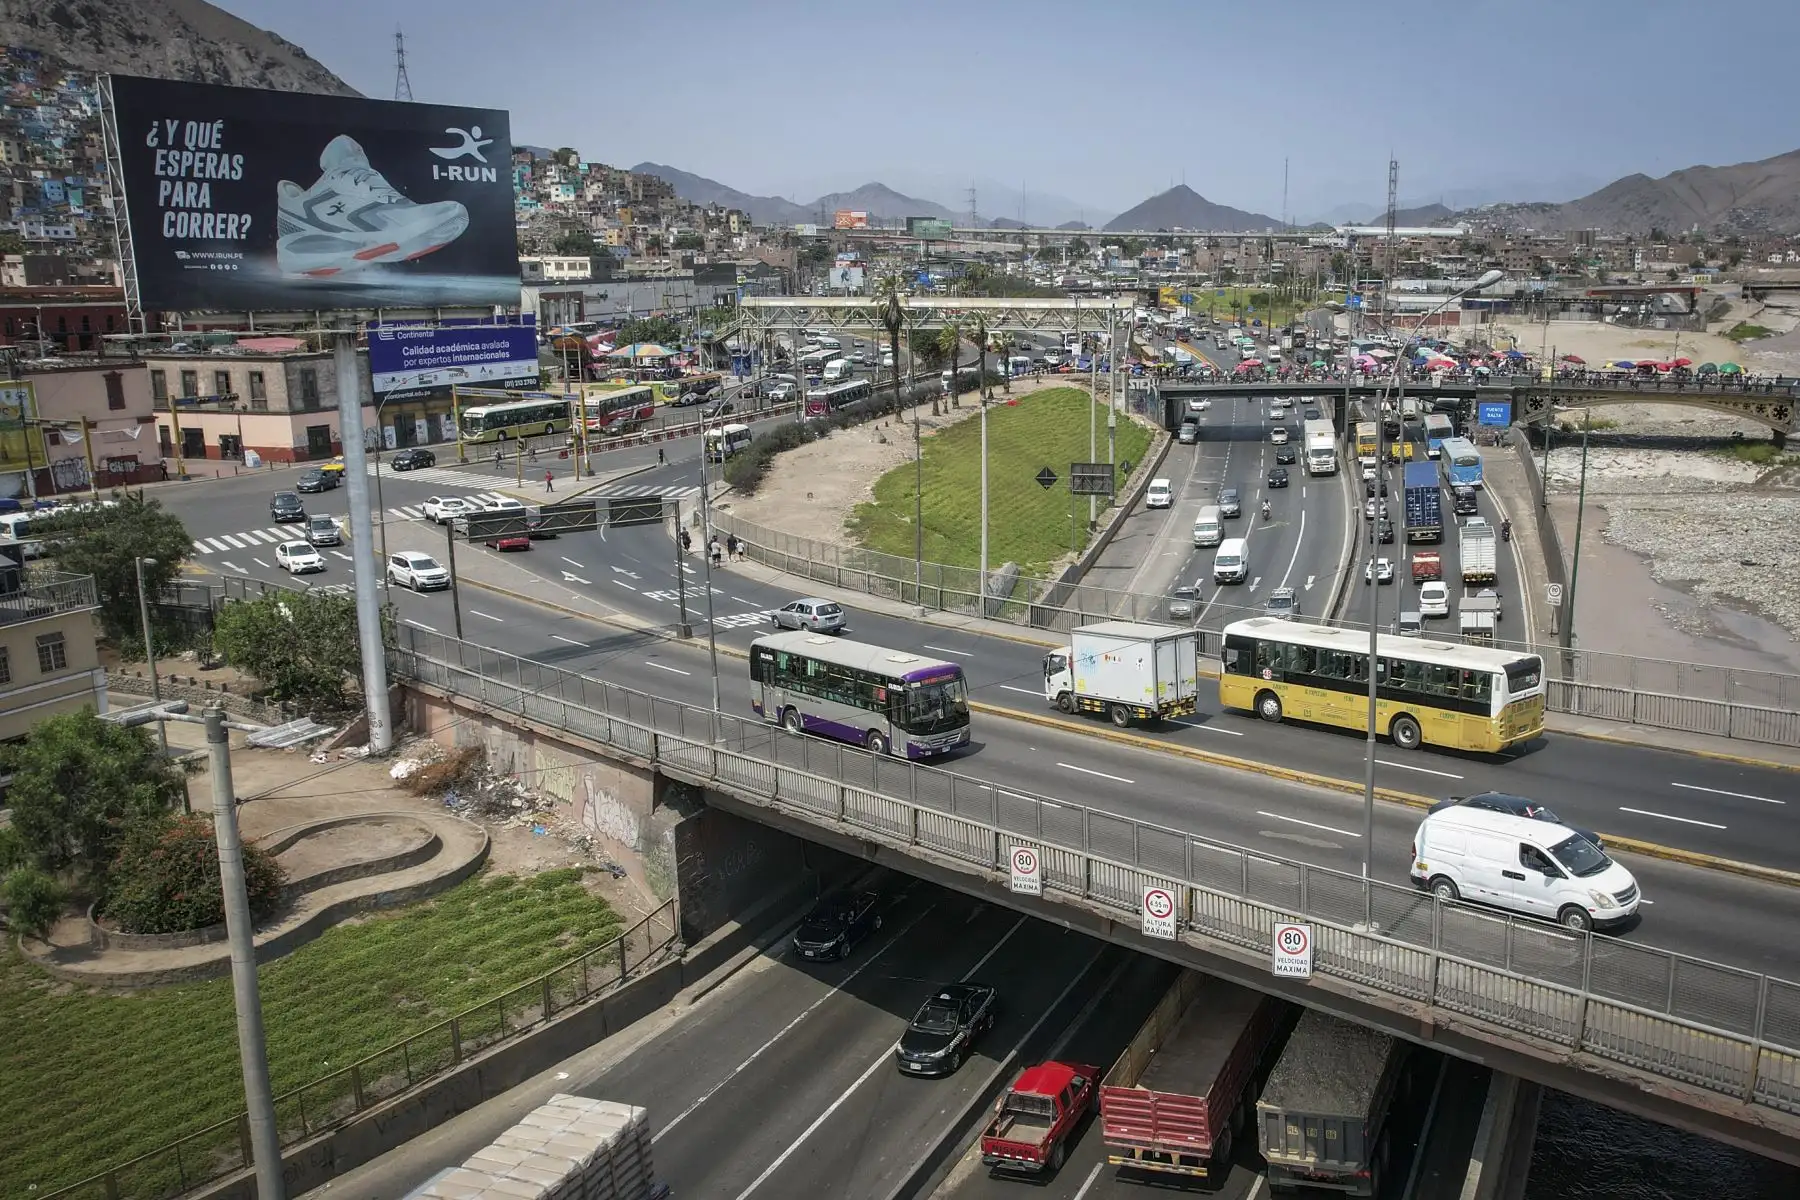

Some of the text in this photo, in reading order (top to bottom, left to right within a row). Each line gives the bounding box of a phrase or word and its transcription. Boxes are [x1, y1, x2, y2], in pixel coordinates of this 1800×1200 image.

[184, 119, 224, 151] QUÉ
[154, 149, 244, 180] ESPERAS
[432, 164, 497, 183] I-RUN
[158, 180, 211, 208] PARA
[163, 210, 252, 240] CORRER?
[397, 330, 435, 340] Continental
[402, 340, 510, 356] Calidad académica avalada
[403, 351, 510, 368] por expertos internacionales
[1018, 854, 1032, 866] 80
[1013, 882, 1039, 891] MAXIMA
[1146, 918, 1172, 929] ALTURA
[1144, 926, 1174, 938] MAXIMA
[1284, 932, 1301, 946] 80
[1277, 957, 1308, 966] VELOCIDAD
[1276, 965, 1308, 975] MAXIMA
